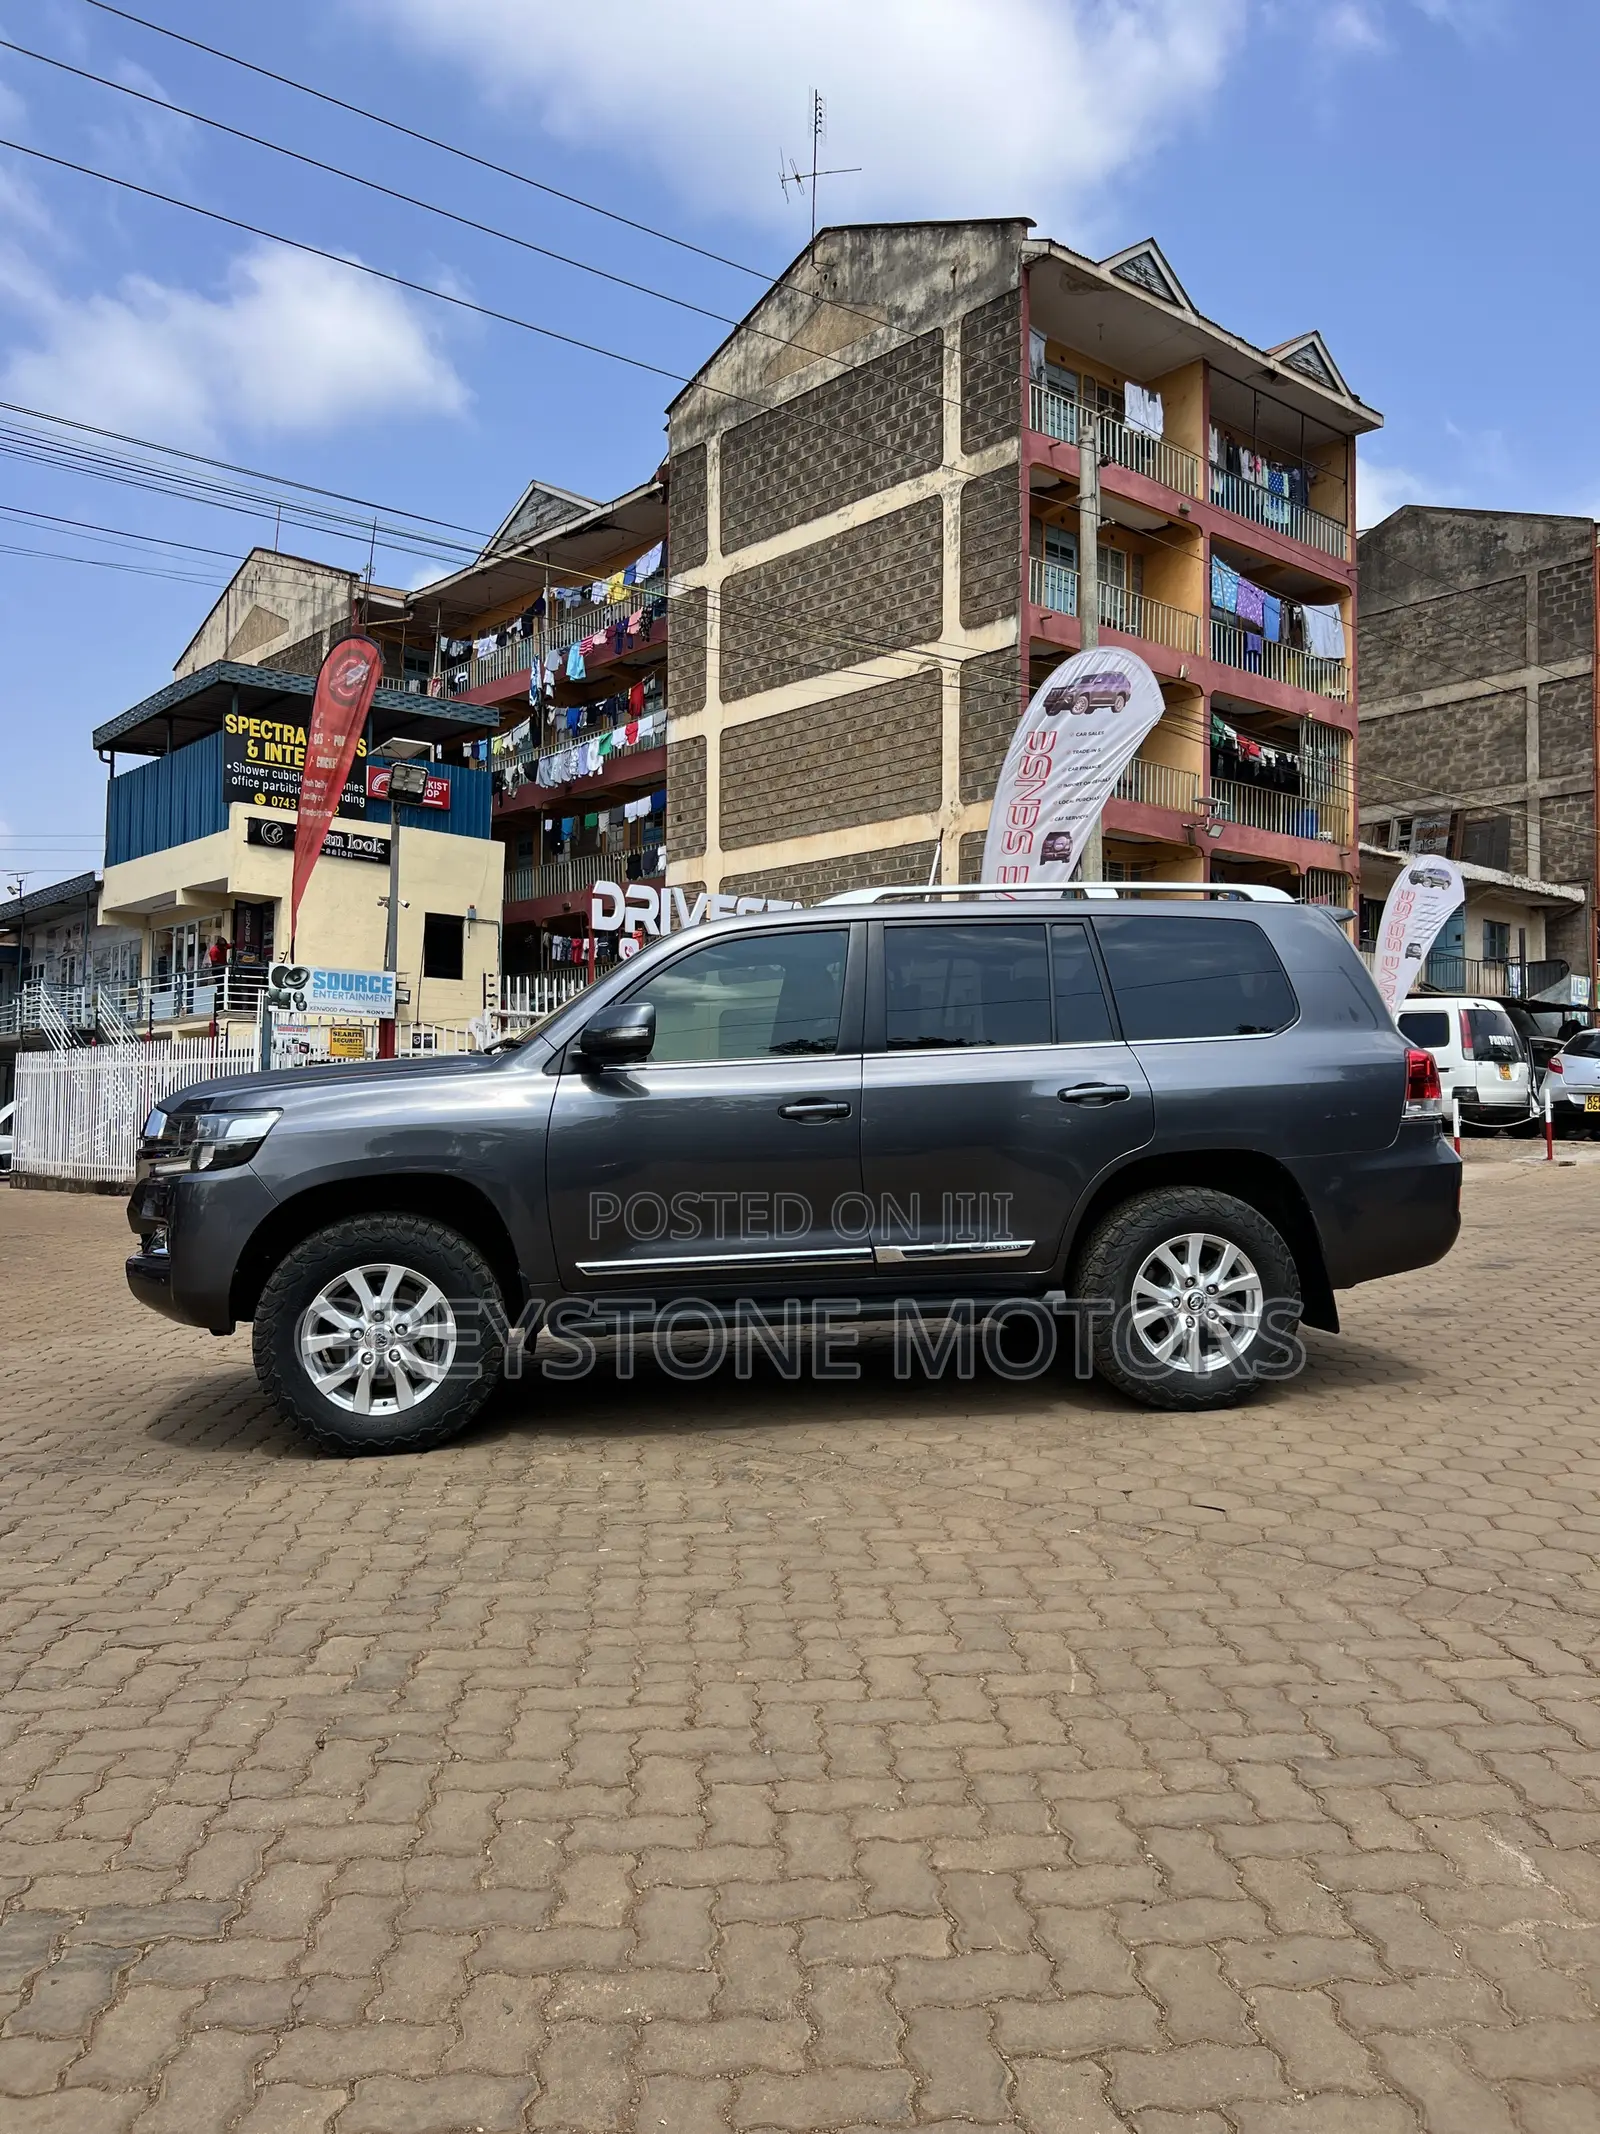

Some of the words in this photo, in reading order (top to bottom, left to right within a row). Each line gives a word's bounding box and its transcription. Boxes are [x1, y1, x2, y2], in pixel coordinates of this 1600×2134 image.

[225, 713, 307, 746] SPECTRA
[247, 739, 259, 758] &
[264, 741, 305, 767] INTE
[233, 762, 269, 777] Shower
[231, 776, 260, 789] office
[426, 780, 448, 792] KIST
[1001, 730, 1057, 855] SENSE
[325, 847, 353, 859] salon
[347, 833, 385, 855] look
[591, 880, 804, 937] DRIVE
[1386, 889, 1416, 953] SENSE
[312, 970, 393, 995] SOURCE
[1380, 955, 1400, 1011] RIVE
[312, 989, 393, 1004] ENTERTAINMENT
[309, 1005, 338, 1013] KENWOOD
